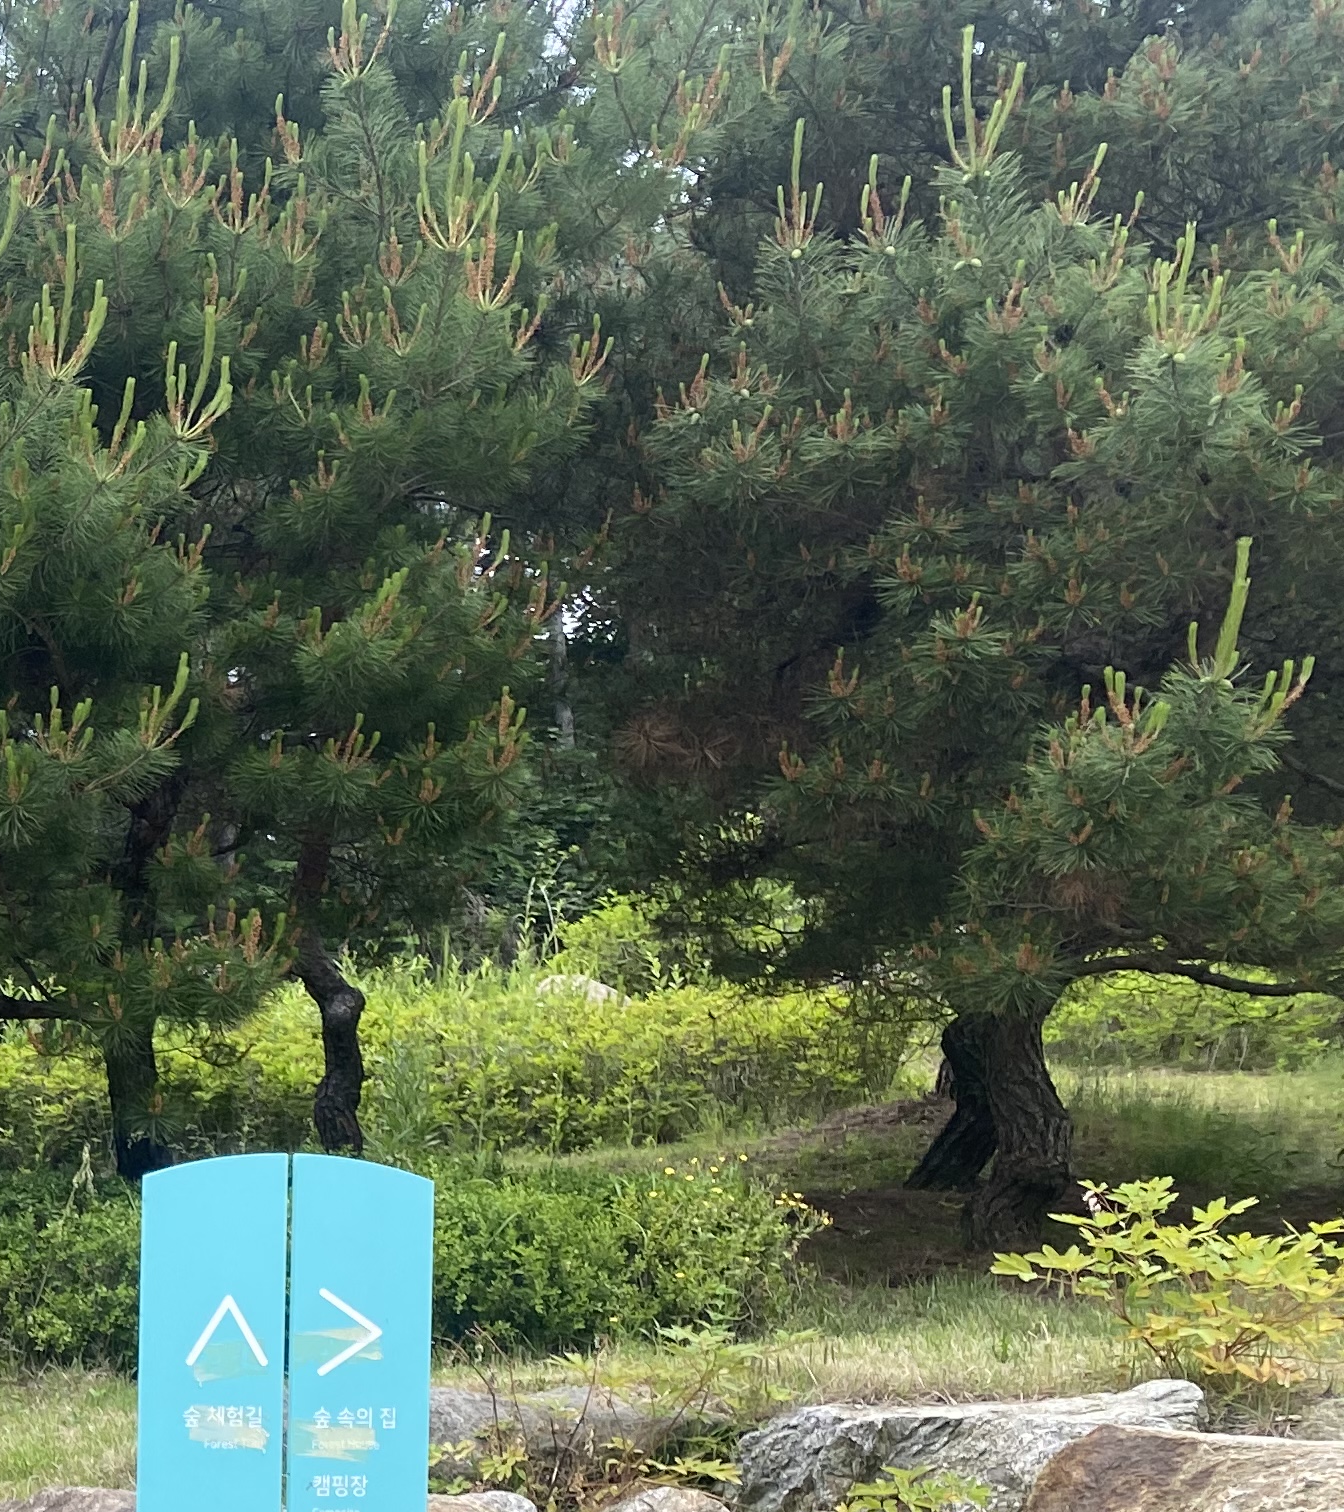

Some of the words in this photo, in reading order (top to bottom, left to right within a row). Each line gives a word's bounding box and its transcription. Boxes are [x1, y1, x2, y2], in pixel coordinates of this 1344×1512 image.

[182, 1405, 201, 1428] 숲
[207, 1405, 263, 1428] 체험길
[313, 1406, 331, 1429] 숲
[337, 1406, 372, 1429] 속의
[380, 1407, 396, 1429] 집
[312, 1474, 368, 1498] 캠핑장
